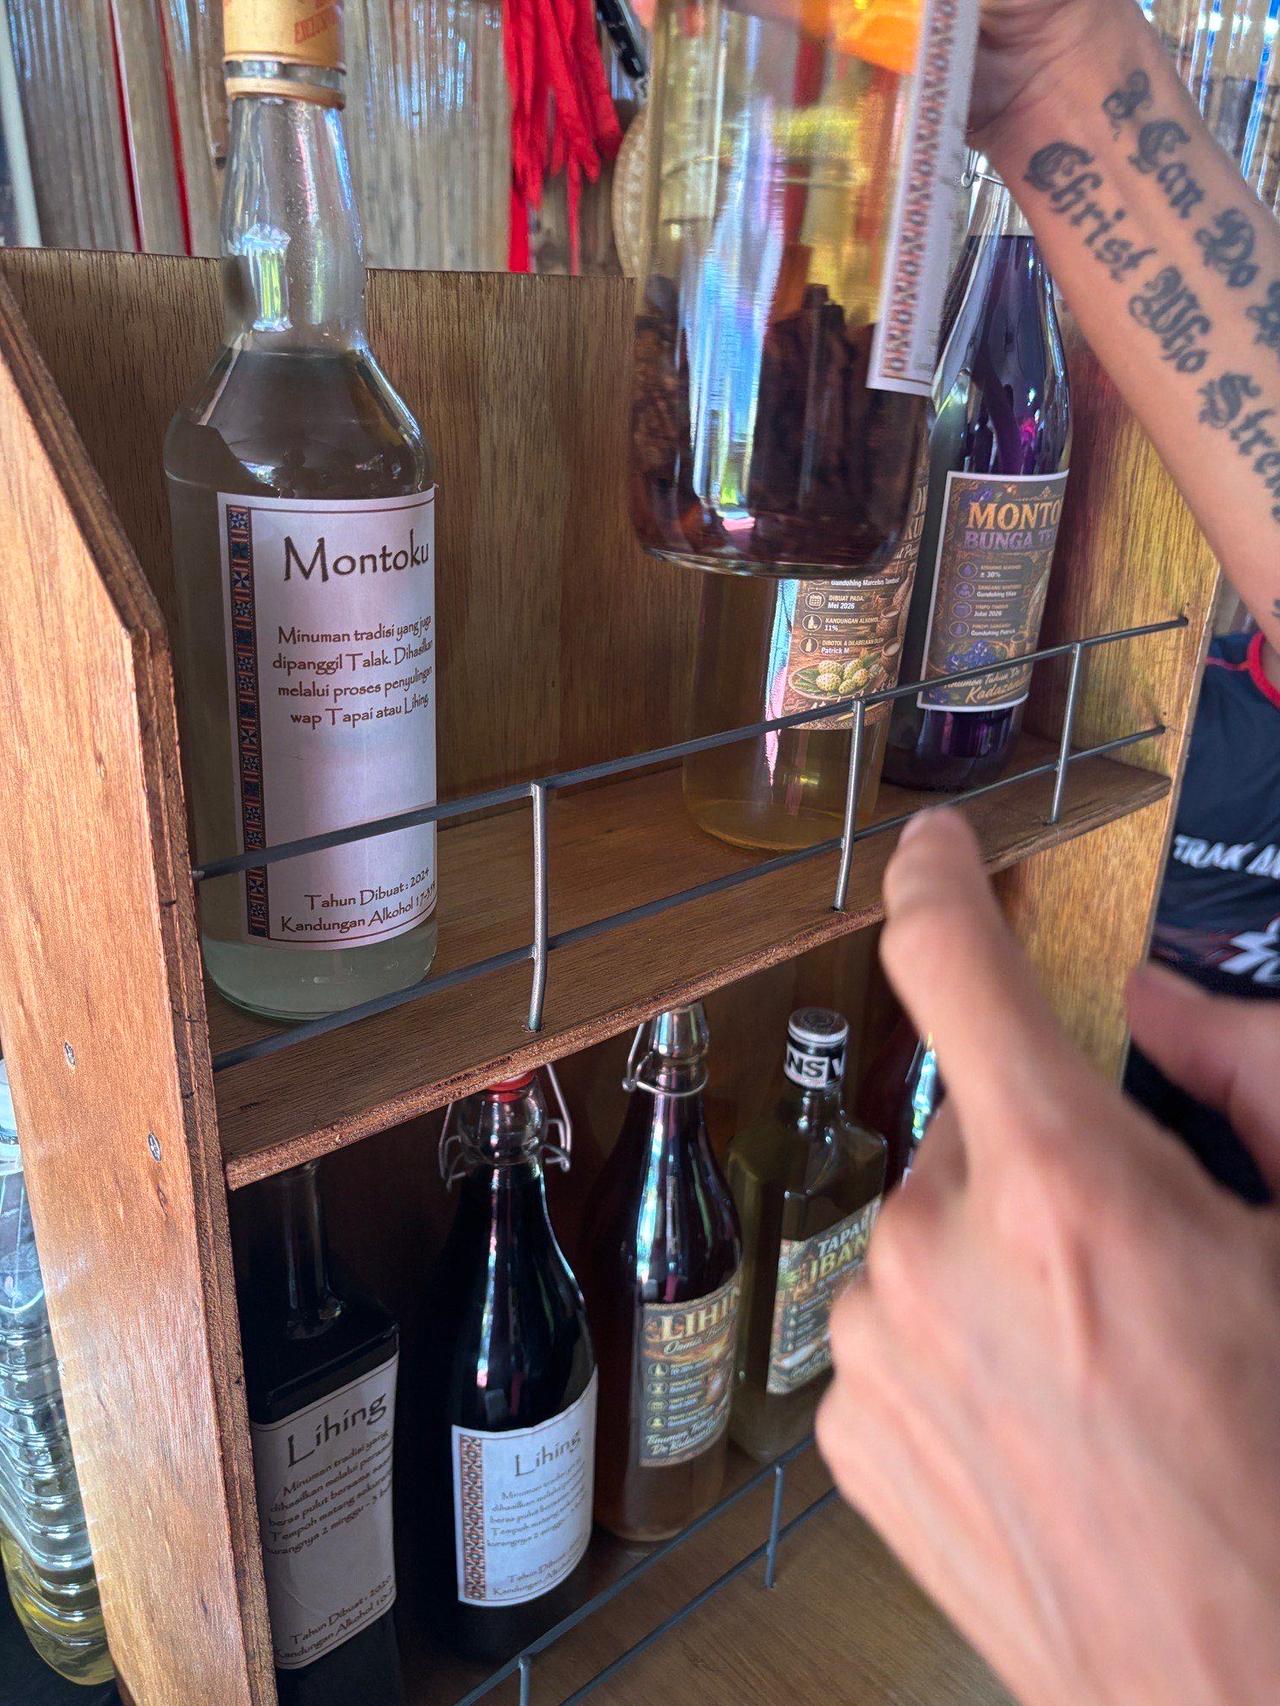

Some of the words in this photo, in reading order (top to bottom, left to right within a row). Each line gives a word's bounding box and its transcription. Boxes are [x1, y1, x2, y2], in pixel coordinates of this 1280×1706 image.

[1128, 119, 1206, 219] Can
[1196, 207, 1260, 288] Do
[1022, 140, 1159, 283] Christ
[1127, 265, 1213, 373] Who
[1197, 372, 1280, 524] Stre
[963, 531, 1034, 550] BUNGA
[283, 528, 430, 583] Montoku
[278, 626, 351, 645] Minuman
[354, 623, 395, 642] tradisi
[396, 621, 419, 641] yang
[272, 653, 344, 676] dipanggil
[278, 681, 330, 697] melalui
[333, 684, 382, 703] proses
[290, 713, 322, 730] wap
[325, 706, 374, 729] Tapai
[375, 704, 402, 719] atau
[281, 915, 366, 934] Kandungan
[367, 895, 414, 927] Alkohol
[304, 893, 356, 911] Tahun
[287, 1392, 388, 1468] Lihing
[514, 1429, 583, 1477] Lihing
[288, 1622, 327, 1645] Tahun
